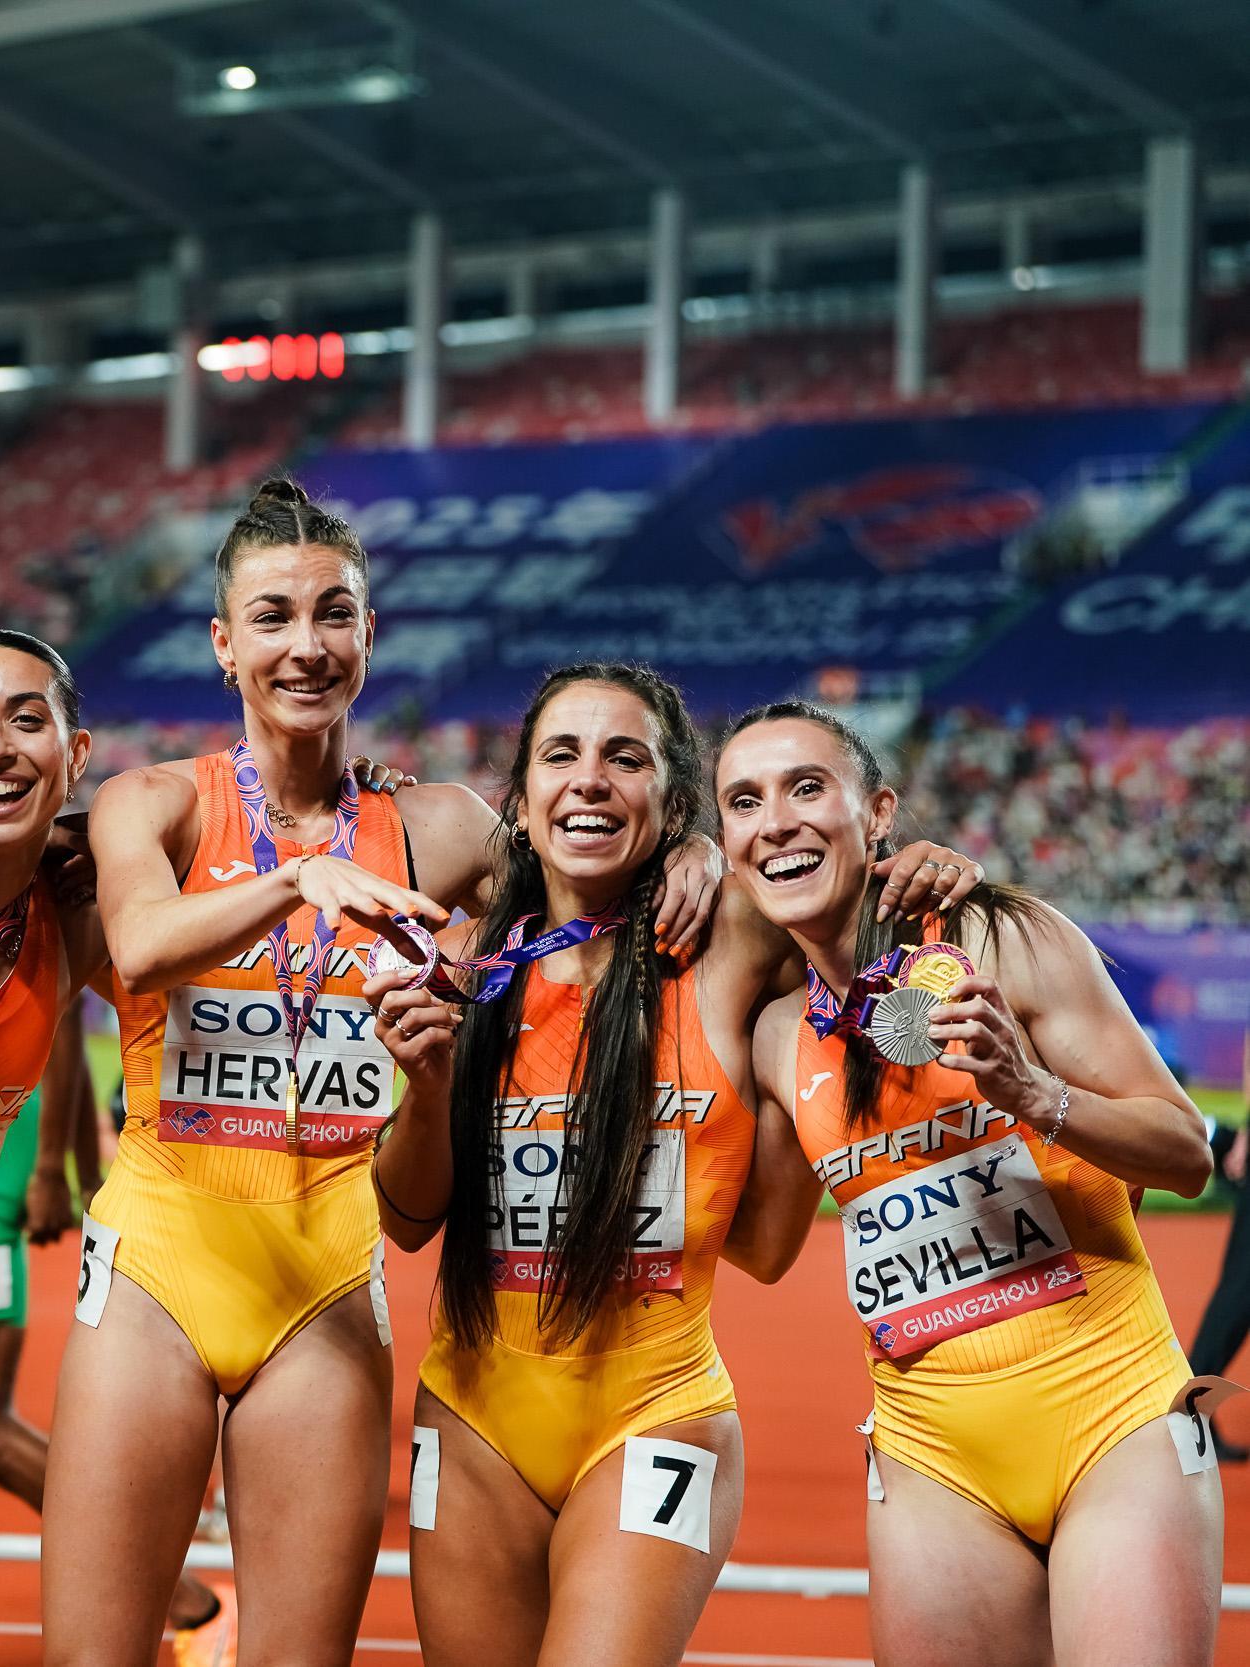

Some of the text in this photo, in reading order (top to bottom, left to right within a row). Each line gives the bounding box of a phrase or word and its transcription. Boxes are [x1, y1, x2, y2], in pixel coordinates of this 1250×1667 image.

[190, 999, 374, 1042] SONY
[176, 1050, 381, 1110] HERVAS
[220, 1116, 354, 1144] GUANZHOU
[856, 1156, 1004, 1248] SONY
[648, 1262, 672, 1279] 25
[854, 1207, 1055, 1316] SEVILLA
[902, 1276, 1040, 1339] GUANGZHOU
[652, 1455, 698, 1525] 7
